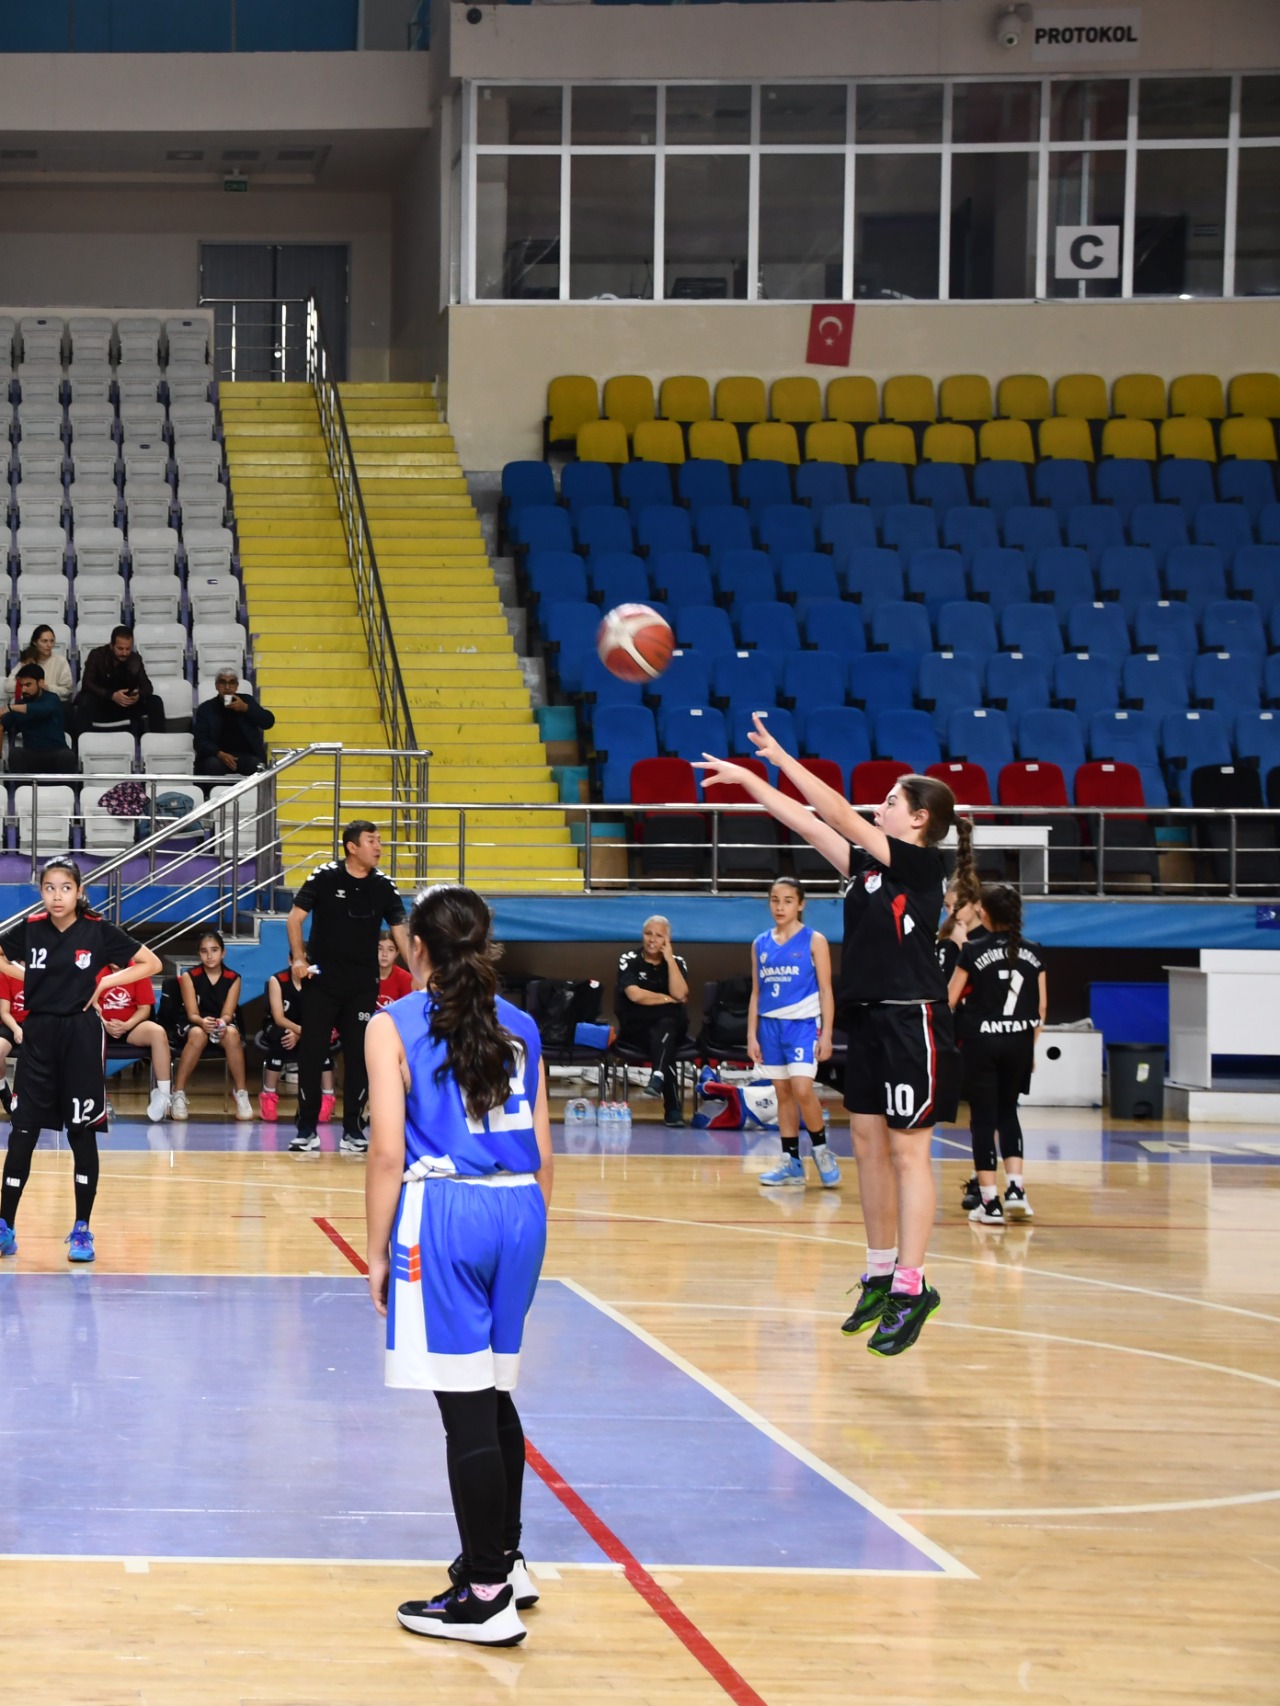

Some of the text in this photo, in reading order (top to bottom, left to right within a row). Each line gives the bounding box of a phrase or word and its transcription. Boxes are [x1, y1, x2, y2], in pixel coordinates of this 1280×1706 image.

[1034, 26, 1138, 44] PROTOKOL
[1070, 234, 1104, 270] C
[29, 947, 48, 969] 12
[974, 947, 1005, 971] ATATÜRK
[771, 983, 780, 997] 3
[998, 969, 1024, 1016] 7
[358, 1011, 371, 1022] 99
[794, 1047, 804, 1062] 3
[459, 1040, 533, 1134] 2
[884, 1081, 914, 1117] 10
[71, 1097, 95, 1124] 12
